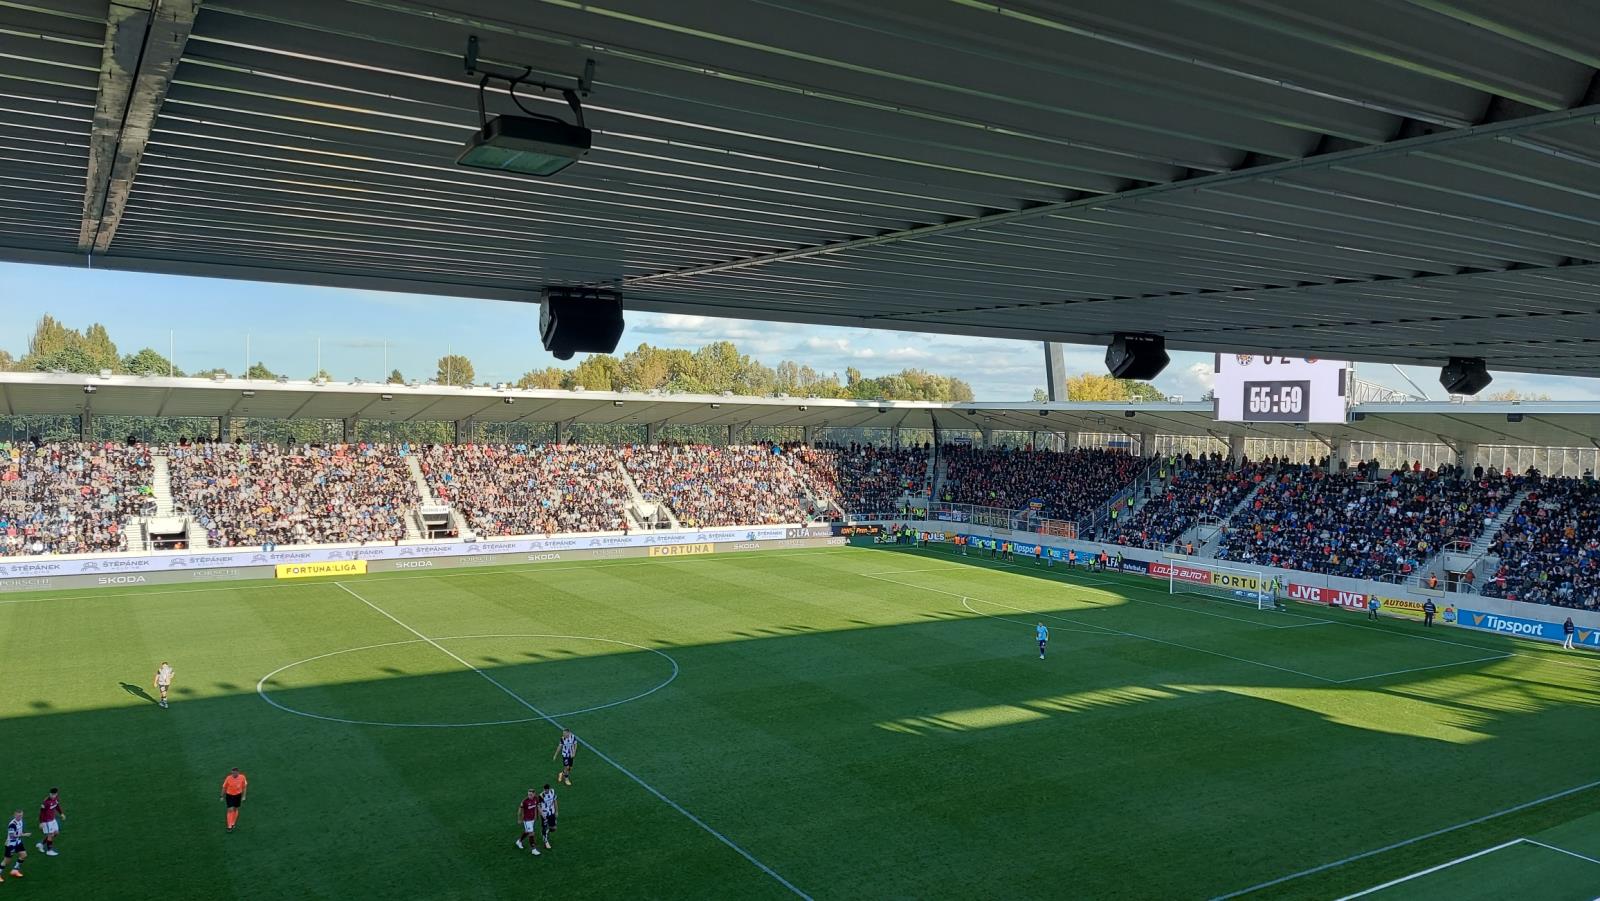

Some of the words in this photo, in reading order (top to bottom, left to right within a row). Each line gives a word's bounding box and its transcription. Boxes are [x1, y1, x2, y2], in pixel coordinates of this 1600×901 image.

[1250, 386, 1303, 413] 55:59
[796, 528, 810, 537] LFA
[654, 544, 709, 556] FORTUNA
[1013, 542, 1036, 554] Tipspor
[286, 565, 332, 575] FORTUNA
[335, 563, 357, 572] LIGA
[1292, 585, 1320, 601] JVC
[1333, 592, 1363, 608] JVC
[1487, 615, 1544, 636] Tipsport
